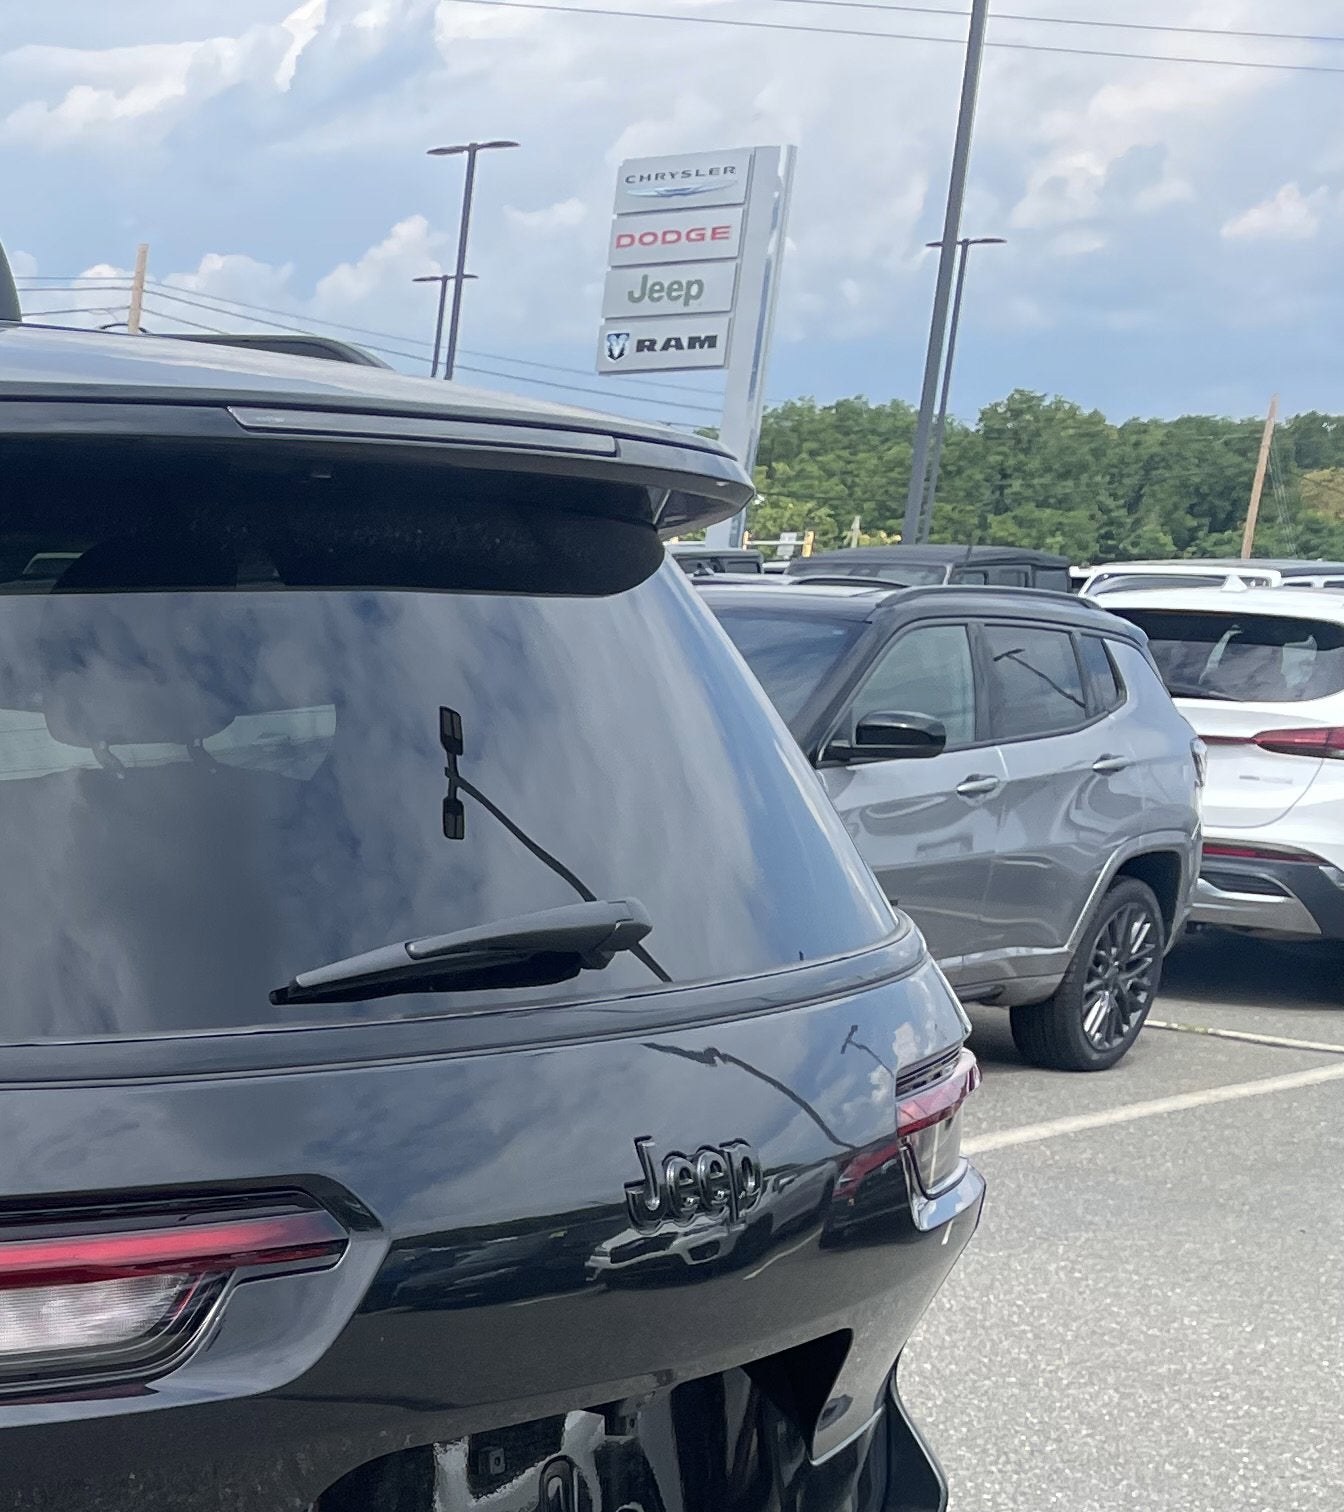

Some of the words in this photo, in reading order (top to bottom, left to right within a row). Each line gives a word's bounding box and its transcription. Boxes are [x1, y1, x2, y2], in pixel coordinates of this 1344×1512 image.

[624, 165, 737, 184] CHRYSLER
[615, 225, 732, 249] DODGE
[627, 274, 705, 306] Jeep
[635, 334, 718, 353] RAM
[623, 1135, 762, 1234] Jeep
